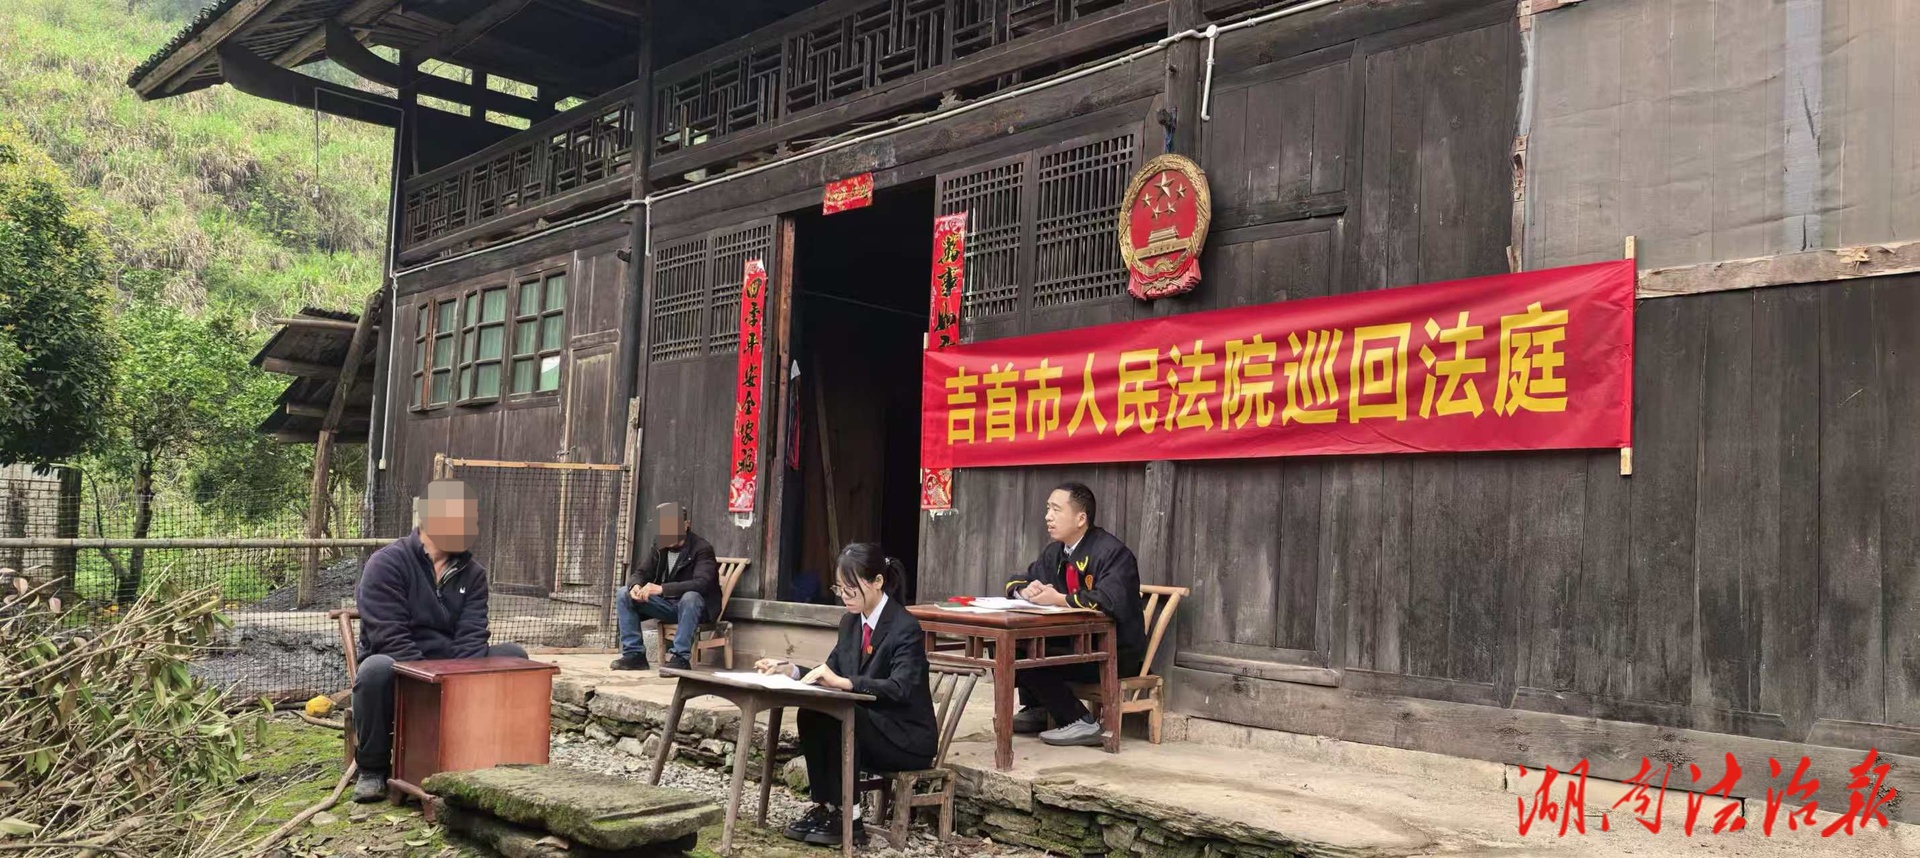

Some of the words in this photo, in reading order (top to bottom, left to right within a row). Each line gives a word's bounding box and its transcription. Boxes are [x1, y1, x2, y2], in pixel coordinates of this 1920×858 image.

[945, 301, 1570, 445] 吉首市人民法院巡回法庭
